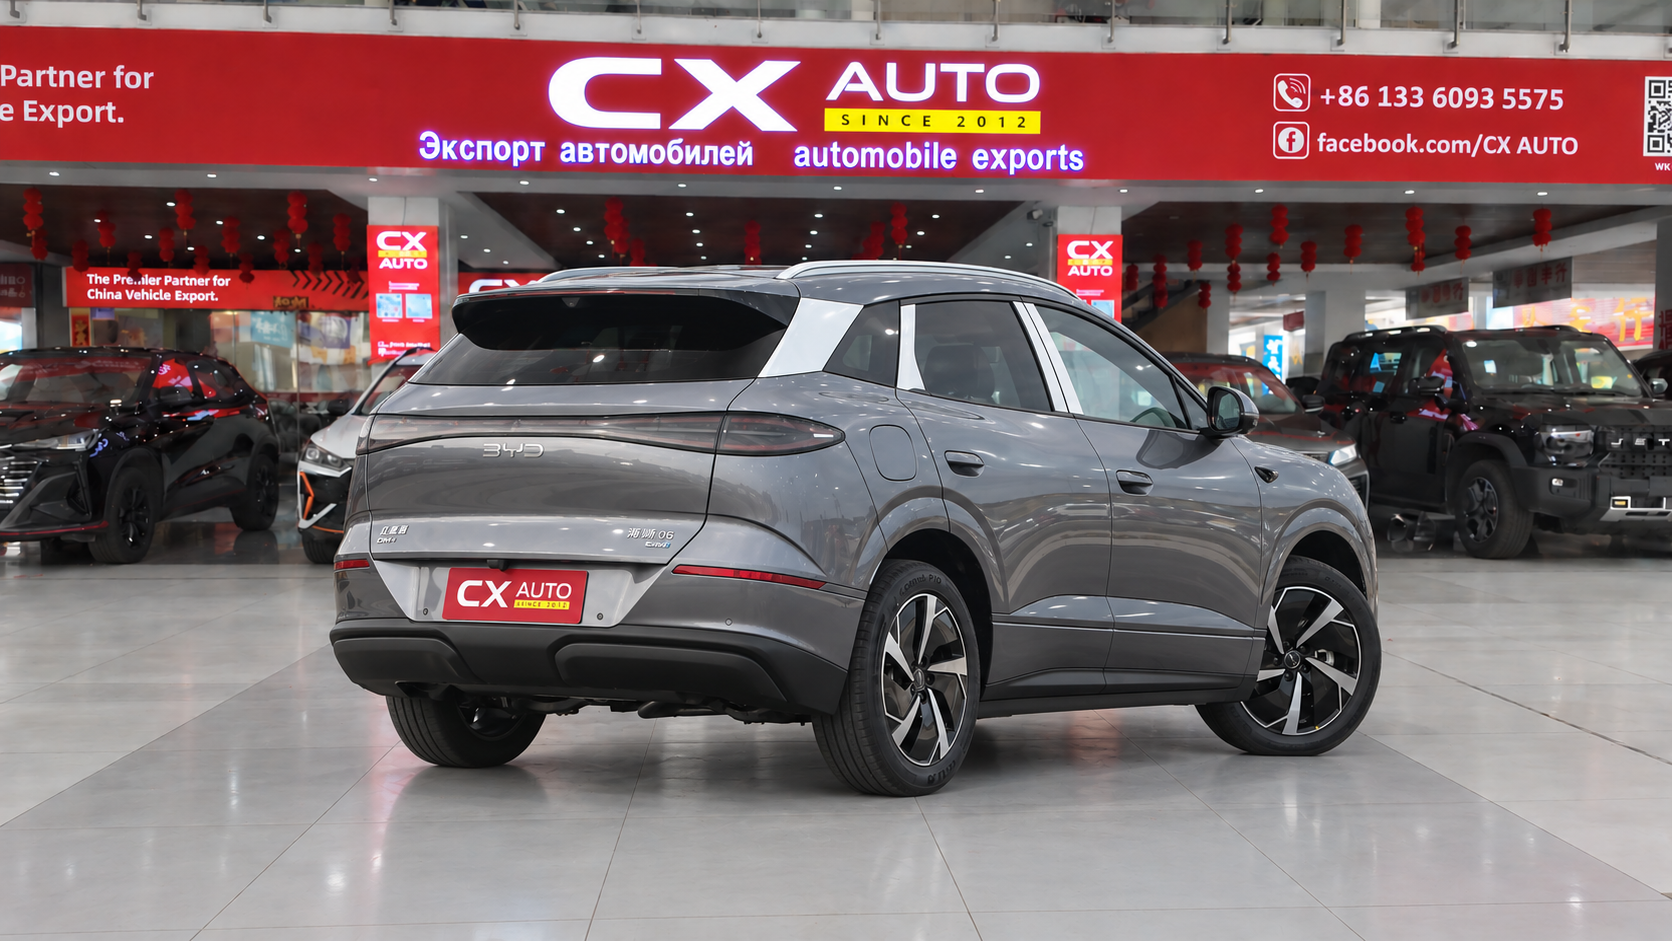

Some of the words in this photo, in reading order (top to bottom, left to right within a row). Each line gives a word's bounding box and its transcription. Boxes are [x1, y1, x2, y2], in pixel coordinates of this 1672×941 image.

[0, 64, 106, 89] Partner
[113, 65, 155, 89] for
[547, 56, 802, 132] CX
[825, 61, 1041, 103] AUTO
[1320, 85, 1370, 107] +86
[1378, 86, 1424, 108] 133
[1432, 87, 1495, 109] 6093
[1502, 88, 1564, 110] 5575
[23, 100, 125, 129] Export.
[841, 114, 931, 127] SINCE
[957, 116, 1026, 129] 2012
[418, 130, 546, 168] Экспорт
[560, 137, 753, 166] автомобилей
[1317, 132, 1511, 158] facebook.com/CX
[1516, 136, 1579, 155] AUTO
[793, 141, 957, 169] automobile
[972, 144, 1085, 175] exports
[376, 231, 427, 251] CX
[1066, 240, 1114, 260] CX
[378, 258, 428, 270] AUTO
[1067, 265, 1113, 277] AUTO
[86, 273, 110, 285] The
[113, 274, 162, 286] Preier
[164, 275, 211, 287] Partner
[212, 274, 231, 287] for
[86, 288, 122, 300] China
[125, 288, 171, 301] Vehicle
[175, 290, 218, 304] Export.
[482, 442, 545, 458] BYD
[456, 579, 512, 608] CX
[515, 581, 572, 600] AUTO
